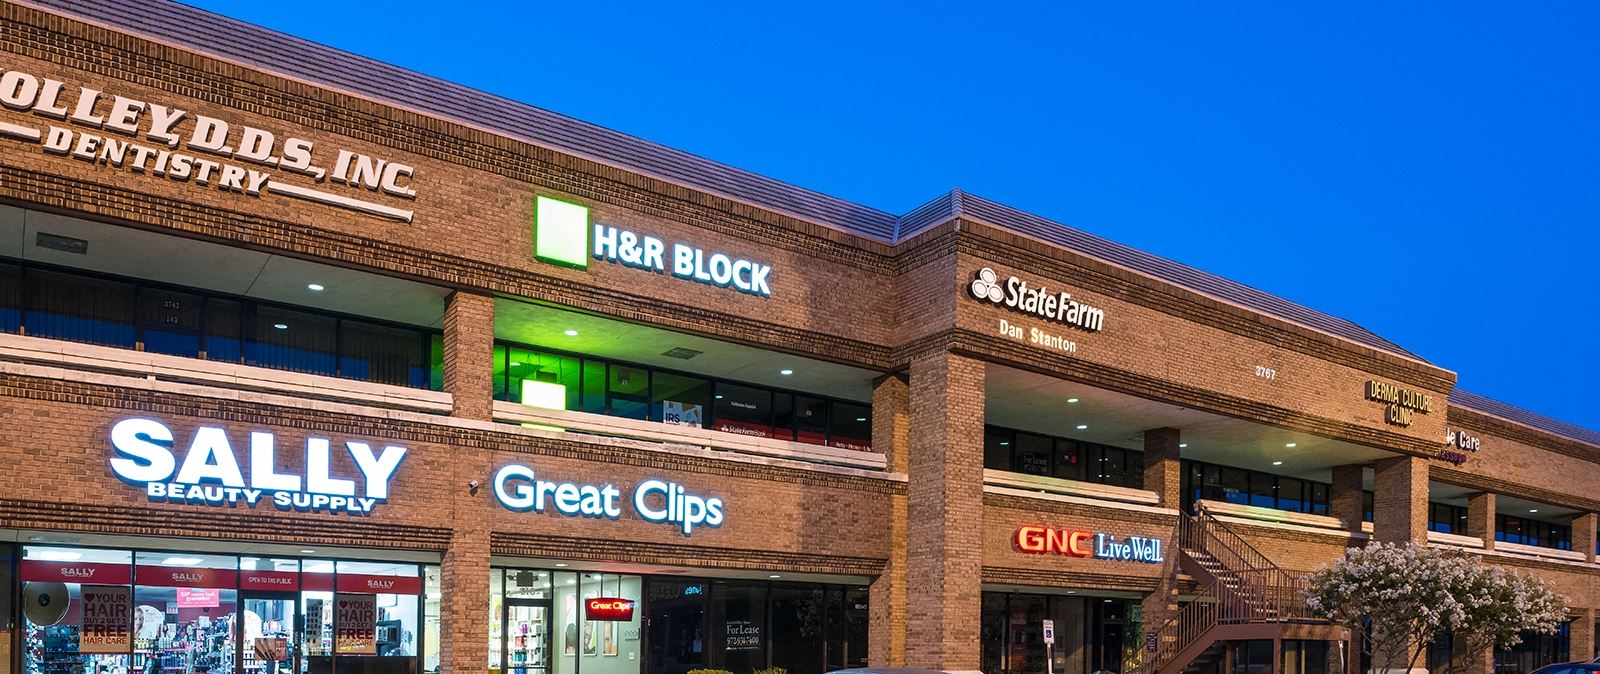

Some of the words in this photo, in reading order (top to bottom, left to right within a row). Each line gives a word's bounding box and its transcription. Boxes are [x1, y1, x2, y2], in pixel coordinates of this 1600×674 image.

[0, 68, 187, 148] OLLEY,
[43, 126, 270, 196] DENTISTRY
[593, 223, 664, 274] H&R
[673, 243, 771, 297] BLOCK
[1000, 319, 1023, 339] Dan
[1030, 327, 1076, 353] Stanton
[1255, 365, 1276, 380] 3767
[1365, 380, 1399, 404] DERMA
[1401, 389, 1433, 414] CULTURE
[665, 412, 681, 423] IRS
[1386, 404, 1414, 427] CLINIC
[1459, 430, 1480, 451] Care
[109, 418, 408, 501] SALLY
[147, 481, 262, 507] BEAUTY
[274, 490, 376, 516] SUPPLY
[493, 464, 621, 519] Great
[633, 480, 724, 535] Clips
[1016, 524, 1093, 558] GNC
[60, 567, 96, 577] SALLY
[171, 572, 204, 581] SALLY
[367, 579, 394, 589] SALLY
[95, 593, 127, 603] YOUR
[348, 600, 374, 610] YOUR
[84, 603, 127, 617] HAIR
[590, 601, 612, 610] Great
[339, 609, 374, 622] HAIR
[83, 624, 127, 637] FREE
[338, 628, 373, 640] FREE
[726, 624, 739, 635] For
[740, 624, 760, 635] Lease
[83, 637, 104, 645] HAIR
[105, 637, 127, 645] CARE
